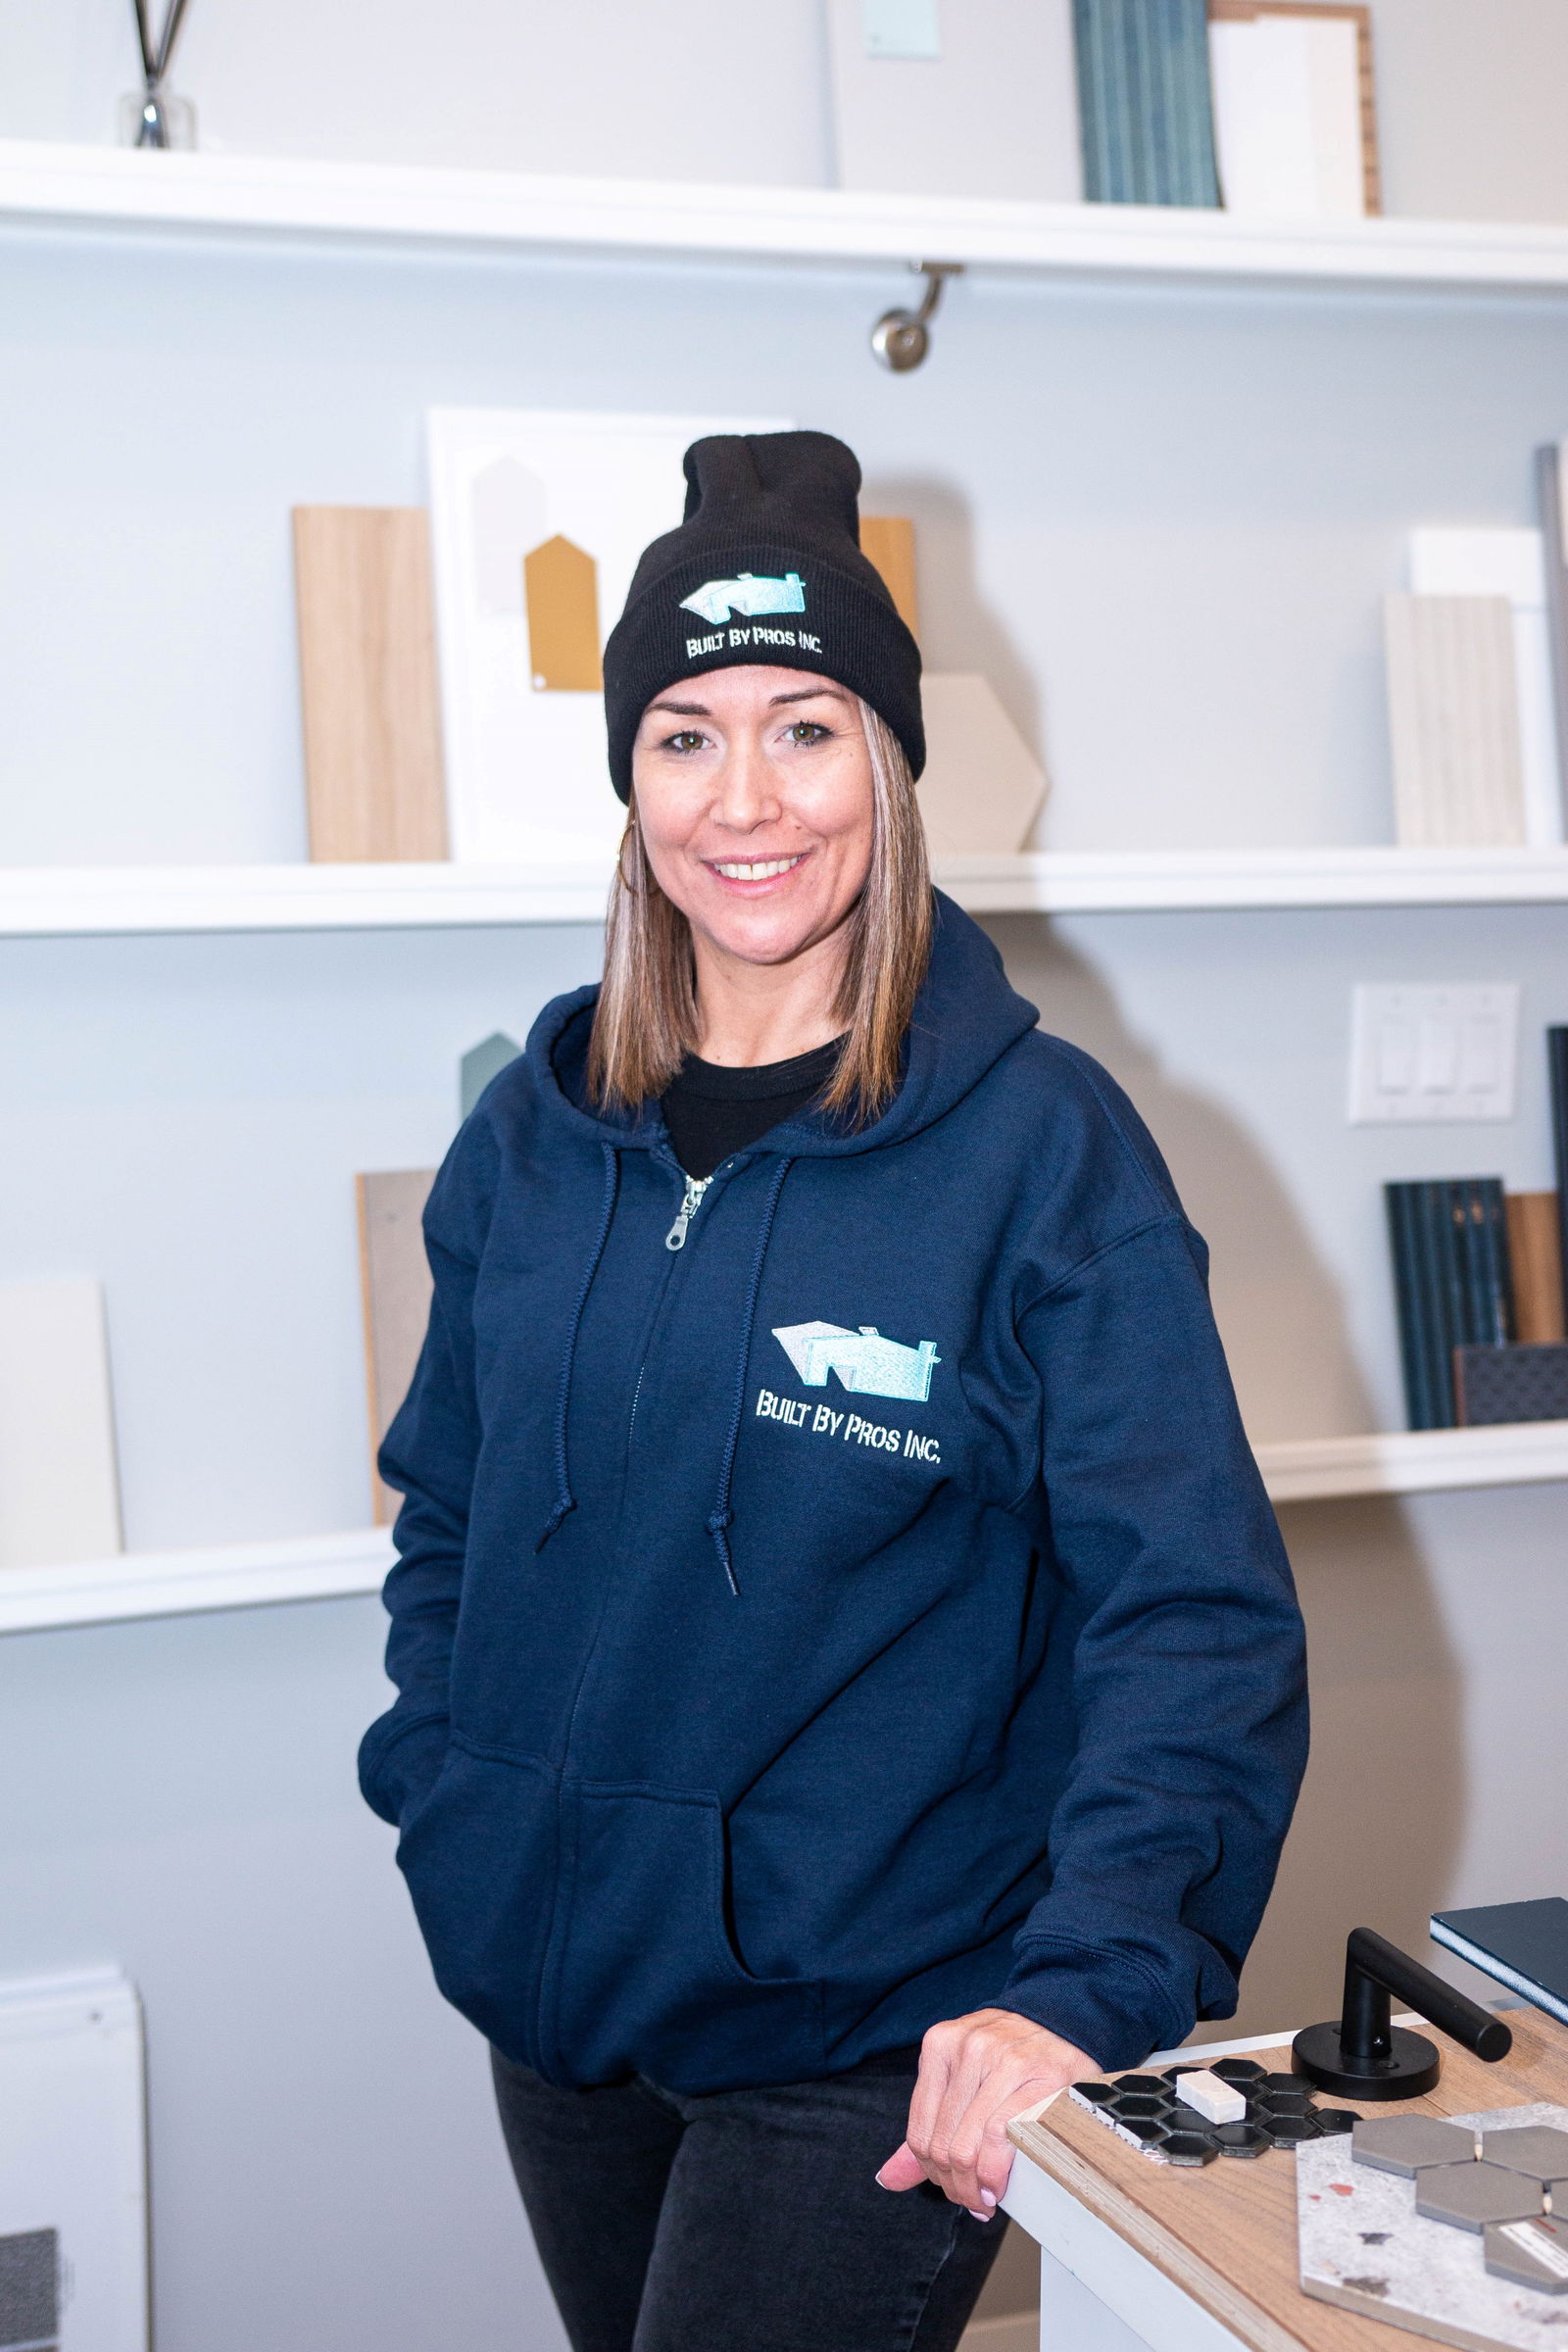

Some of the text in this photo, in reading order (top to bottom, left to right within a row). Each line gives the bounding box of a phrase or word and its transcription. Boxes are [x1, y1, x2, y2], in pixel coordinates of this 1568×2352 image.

[686, 626, 822, 659] BUILT BY PROS INC.
[756, 1389, 941, 1464] BUILT BY PROS INC.
